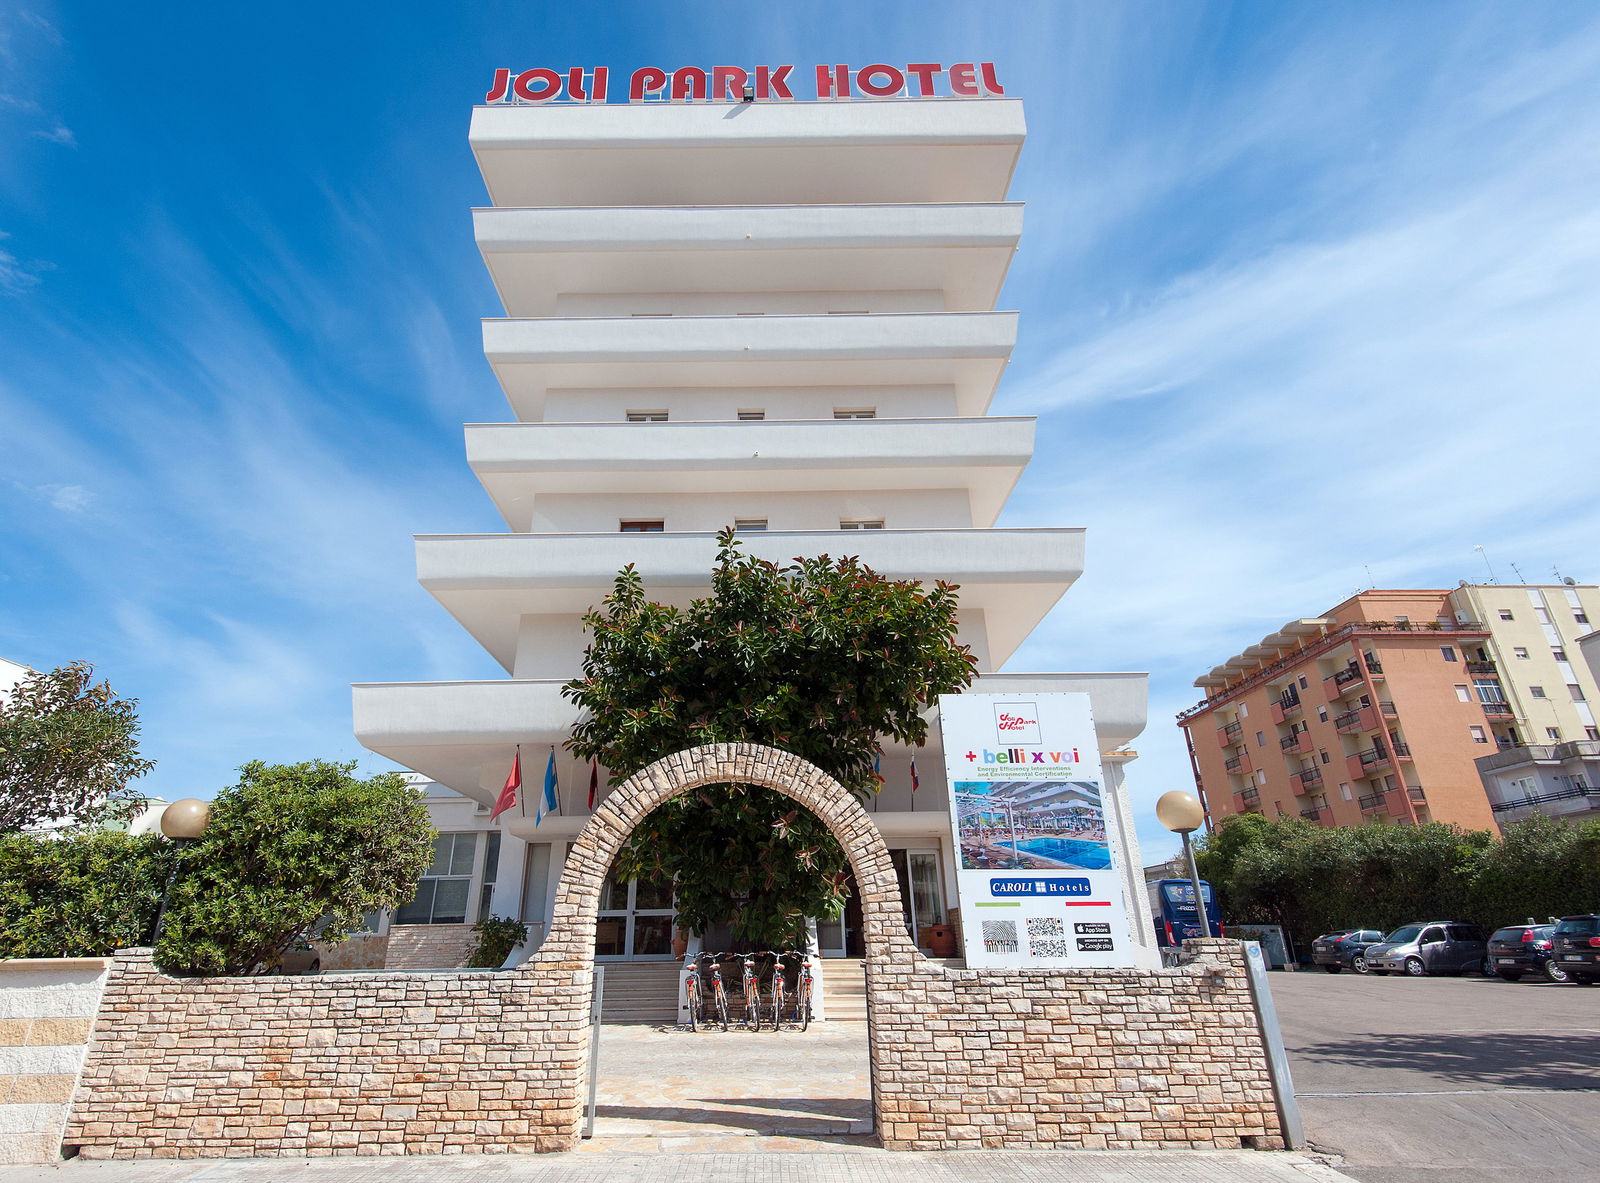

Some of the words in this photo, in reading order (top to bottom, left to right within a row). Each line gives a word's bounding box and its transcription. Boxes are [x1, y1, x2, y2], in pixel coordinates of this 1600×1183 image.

[486, 67, 609, 104] JOLI
[629, 65, 794, 103] PARK
[815, 62, 1005, 99] HOTEL
[983, 748, 1026, 764] belli
[1031, 752, 1045, 763] x
[1049, 748, 1080, 763] voi
[992, 882, 1032, 892] CAROLI
[1049, 883, 1090, 892] Hotels
